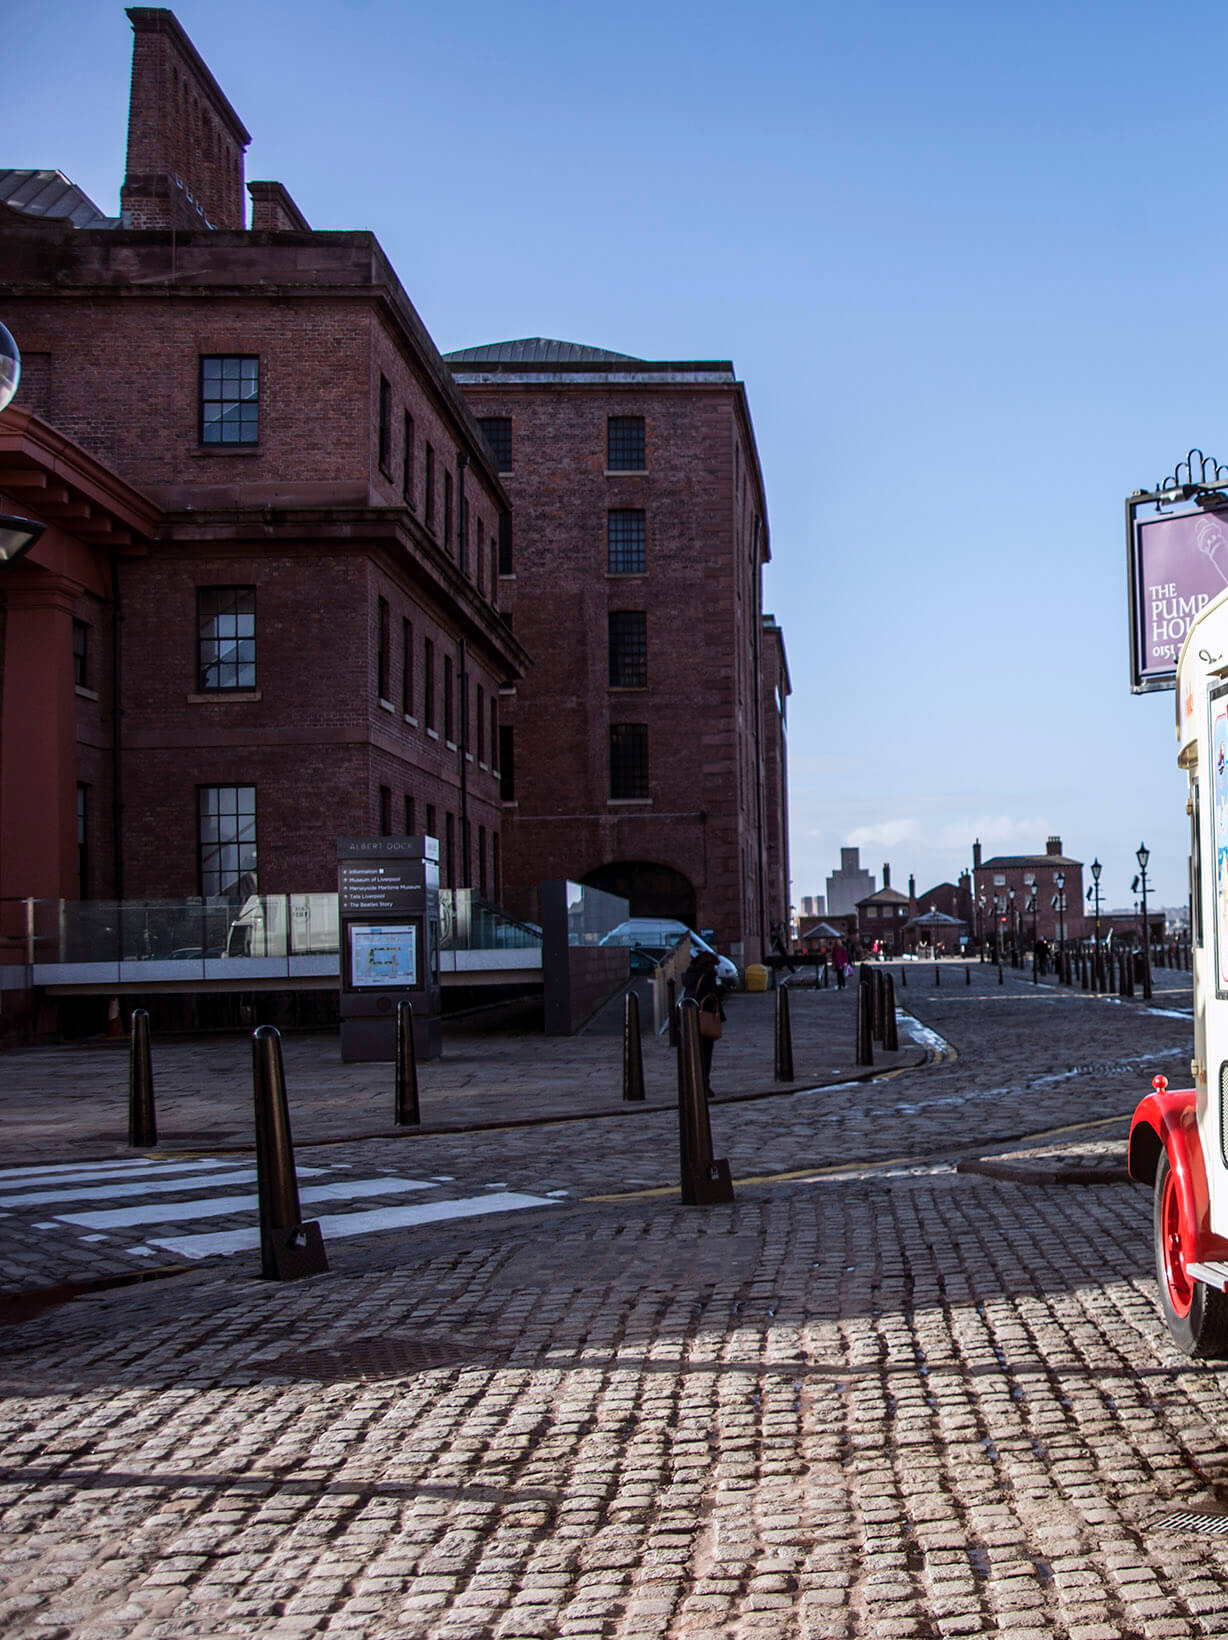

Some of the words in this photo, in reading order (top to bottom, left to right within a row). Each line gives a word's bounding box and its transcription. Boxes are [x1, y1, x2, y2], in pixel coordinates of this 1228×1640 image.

[1149, 583, 1178, 600] THE
[1151, 593, 1209, 621] PUMP
[349, 842, 382, 850] ALBERT
[386, 842, 412, 850] DOCK
